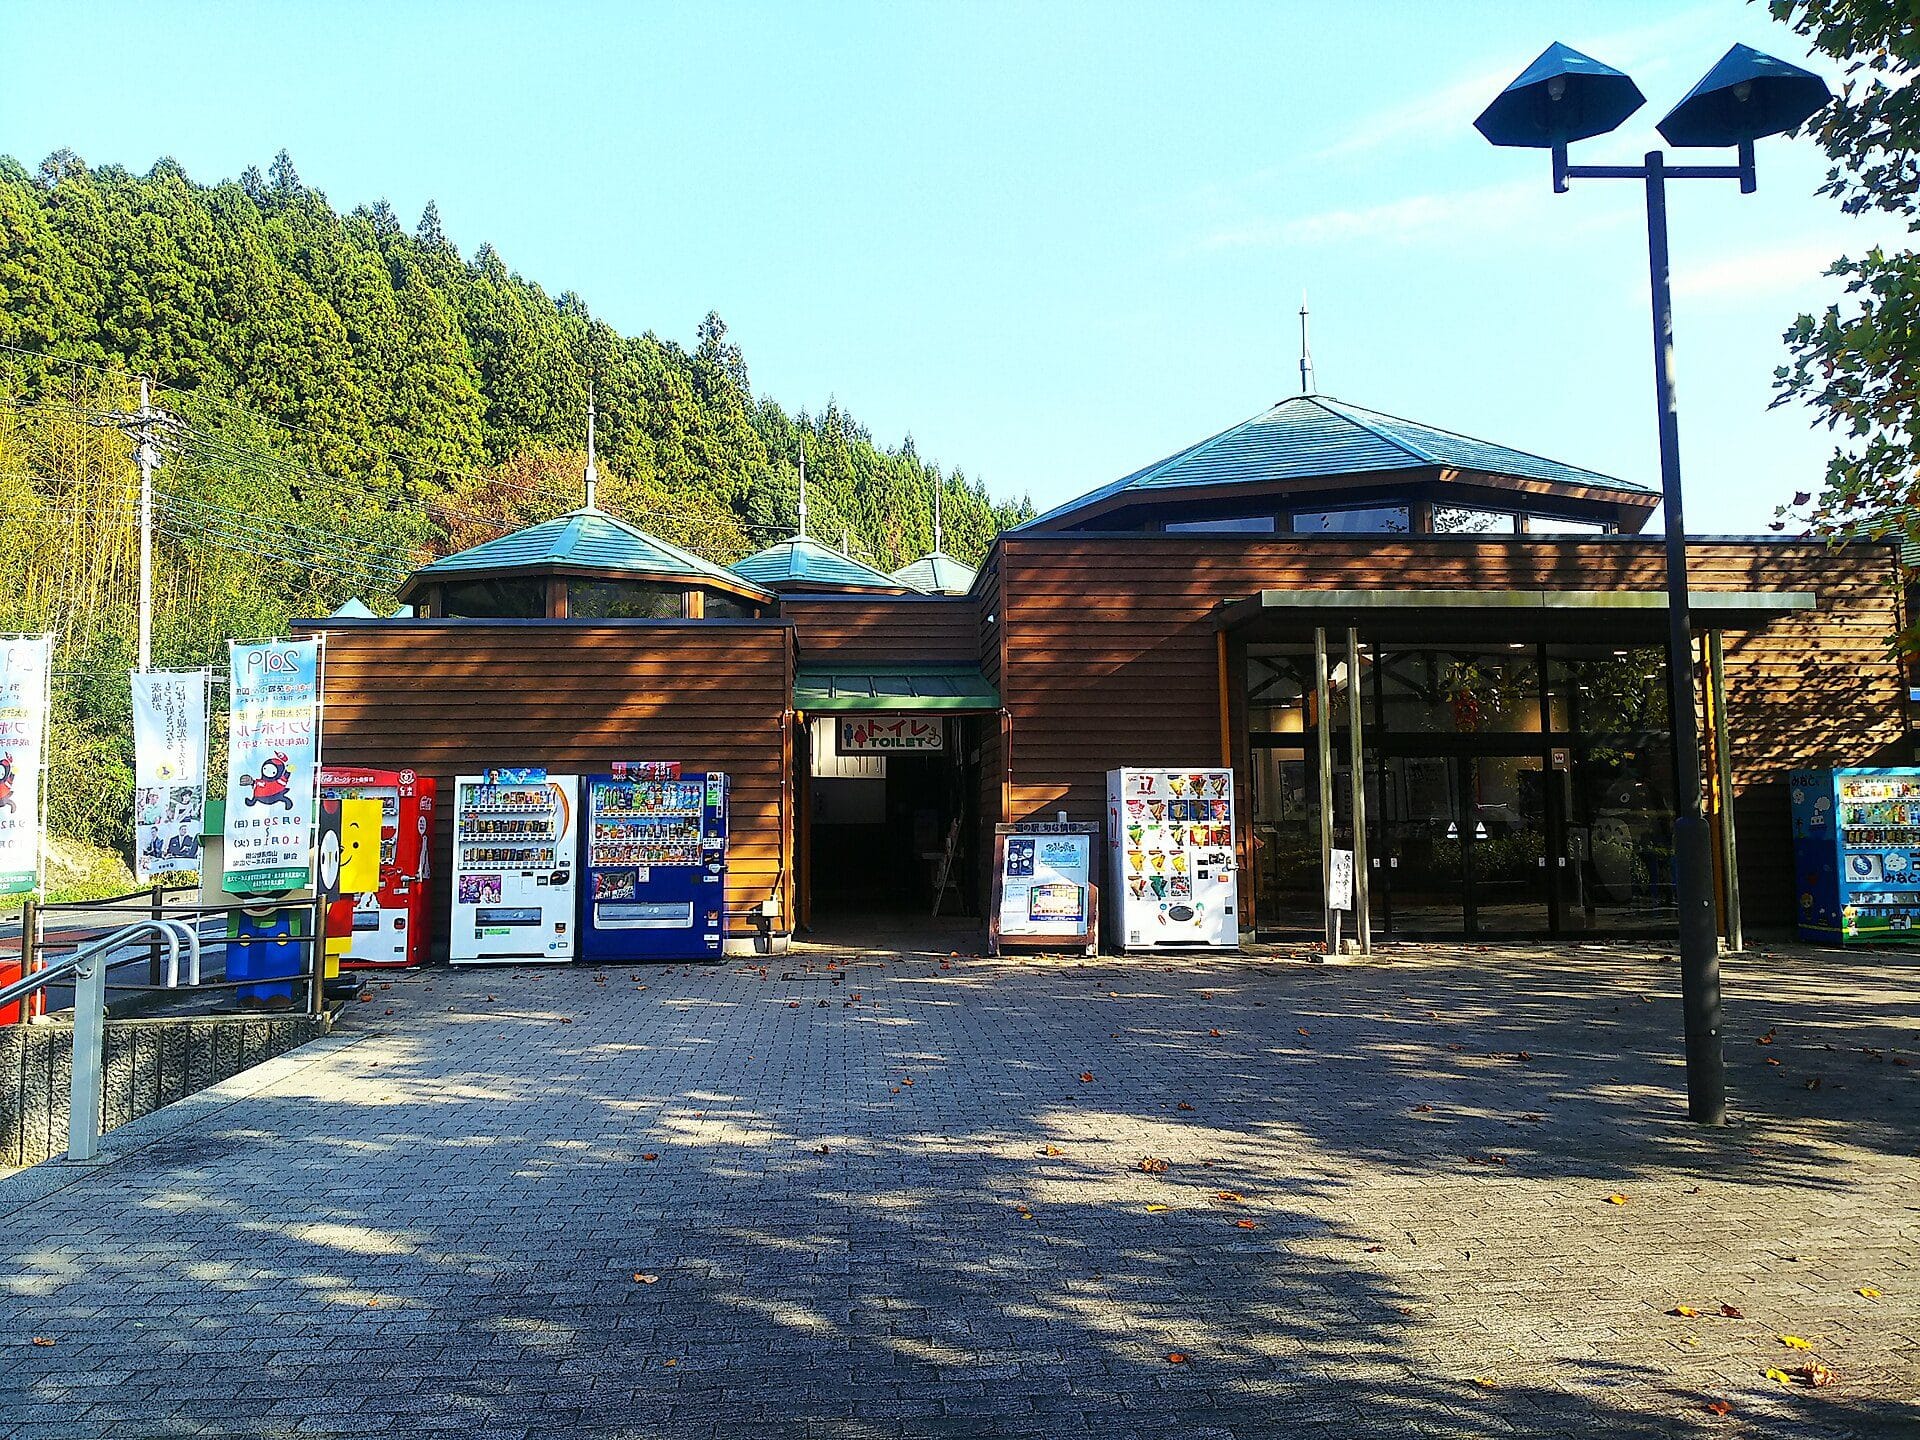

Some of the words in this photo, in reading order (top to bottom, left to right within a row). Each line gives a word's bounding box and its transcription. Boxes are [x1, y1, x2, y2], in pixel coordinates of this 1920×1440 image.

[868, 719, 930, 737] トイレ
[868, 737, 927, 748] TOILET
[1015, 823, 1040, 833] 道の駅
